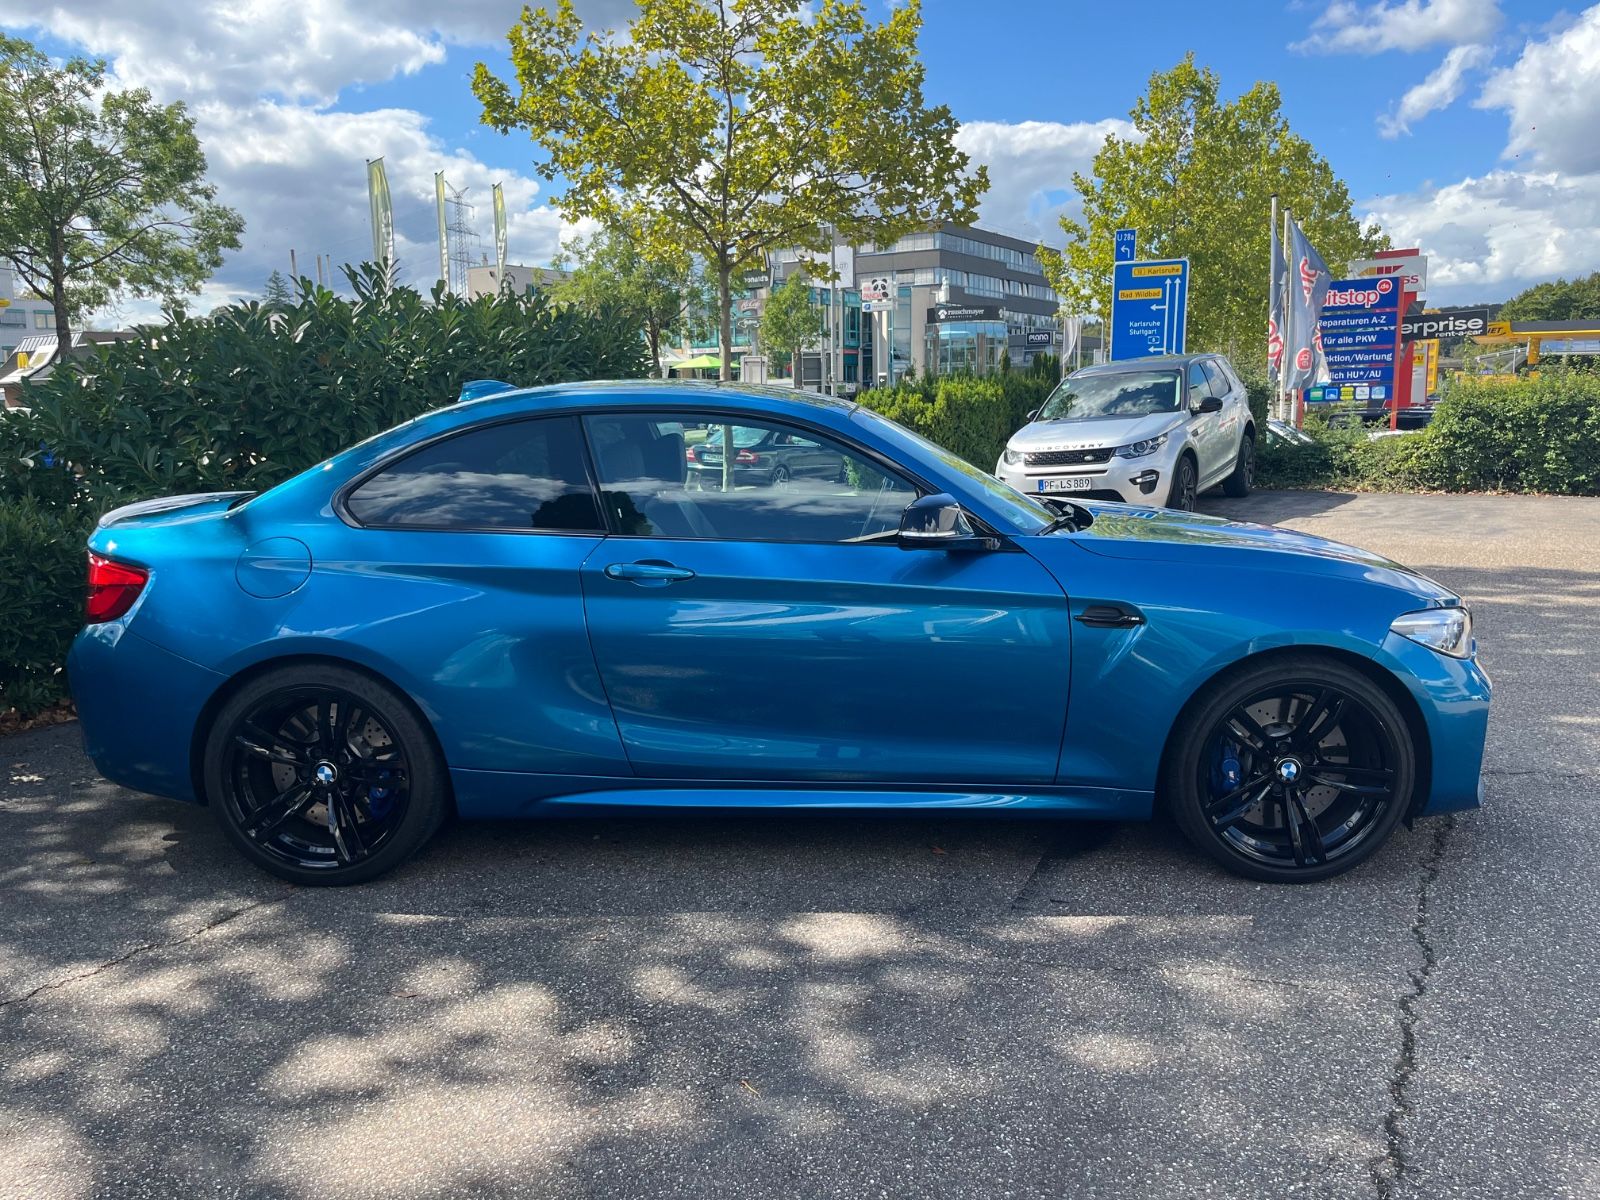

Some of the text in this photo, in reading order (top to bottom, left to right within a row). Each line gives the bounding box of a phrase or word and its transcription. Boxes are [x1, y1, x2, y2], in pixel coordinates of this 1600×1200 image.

[1117, 233, 1123, 241] U
[1148, 266, 1180, 274] Karlsruhe
[1120, 291, 1133, 299] Bad
[1323, 289, 1380, 308] itstop
[1371, 315, 1387, 324] A-Z
[1129, 320, 1161, 328] Karlsruhe
[1400, 316, 1484, 337] erprise
[1129, 328, 1157, 336] Stuttgart
[1323, 334, 1377, 345] für alle PKW
[1325, 352, 1393, 363] ektion/Wartung
[1330, 371, 1344, 379] lich
[1034, 442, 1104, 450] DISCOVERY
[1044, 478, 1090, 490] PF LS 889
